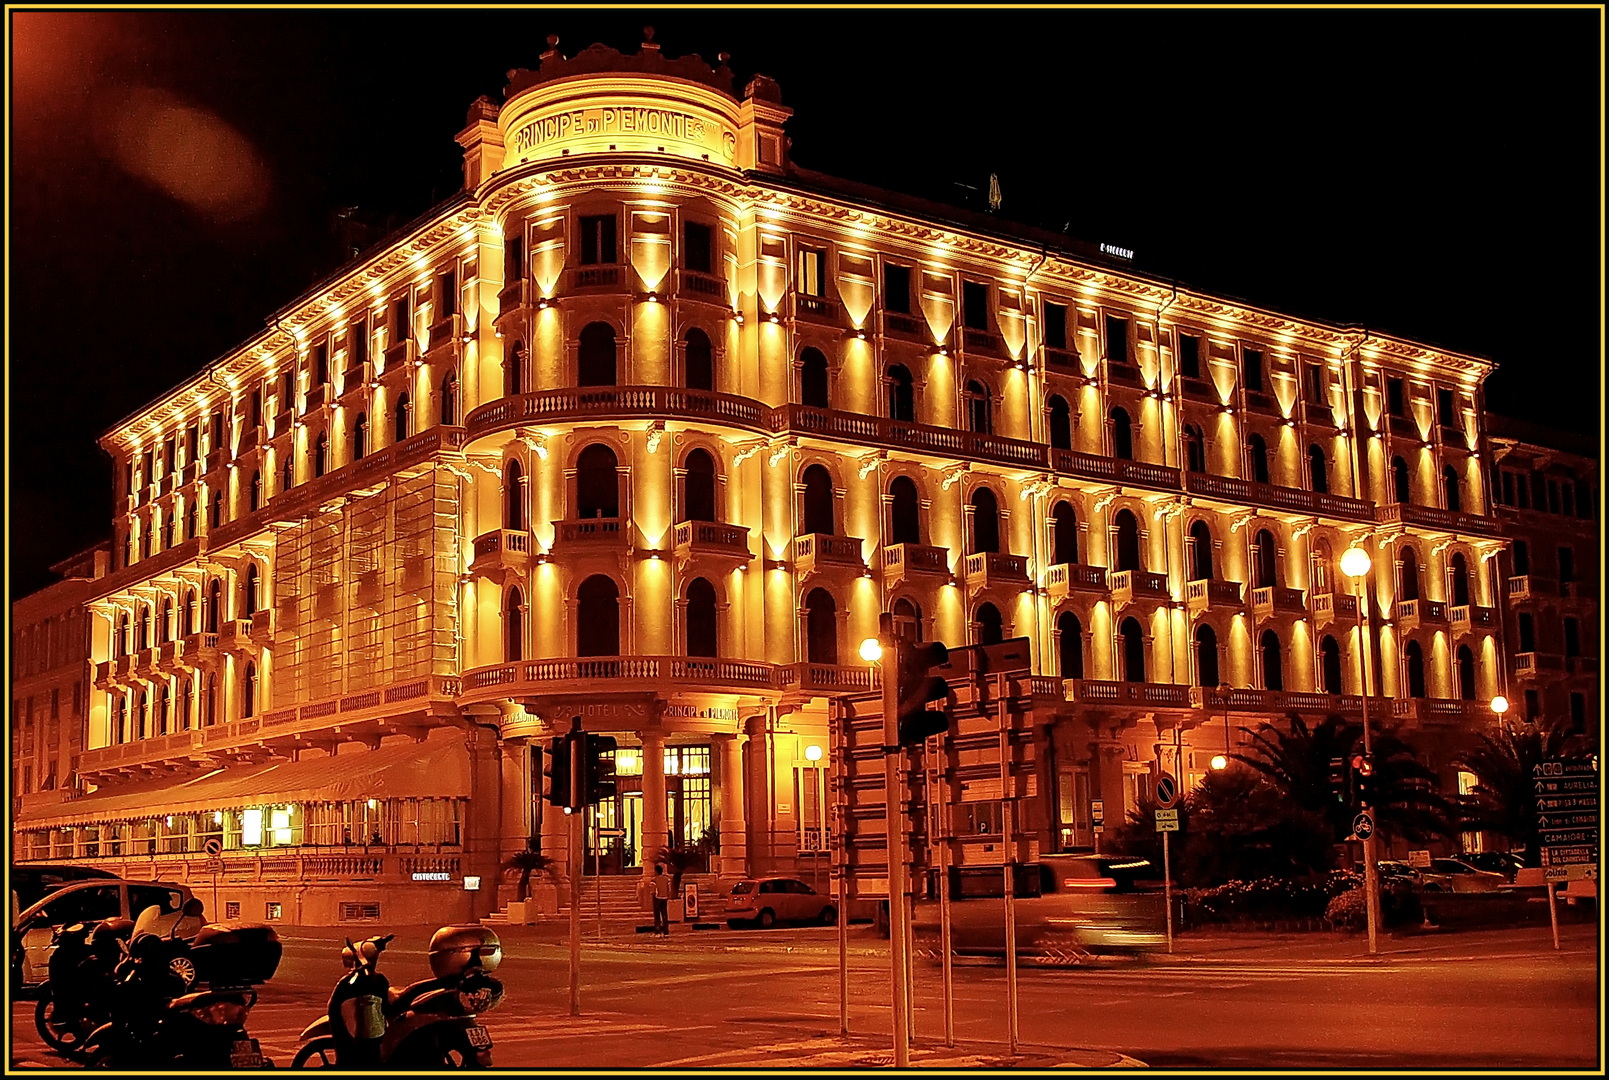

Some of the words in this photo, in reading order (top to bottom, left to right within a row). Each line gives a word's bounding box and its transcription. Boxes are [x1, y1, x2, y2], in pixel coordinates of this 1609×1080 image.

[516, 110, 584, 154] PRINCIPE
[603, 108, 696, 140] PIEMONTE
[578, 705, 618, 716] HOTEL
[1564, 782, 1594, 790] AURELIA
[980, 822, 986, 832] P
[1545, 832, 1586, 843] CAMAIORE
[1551, 849, 1558, 857] LA
